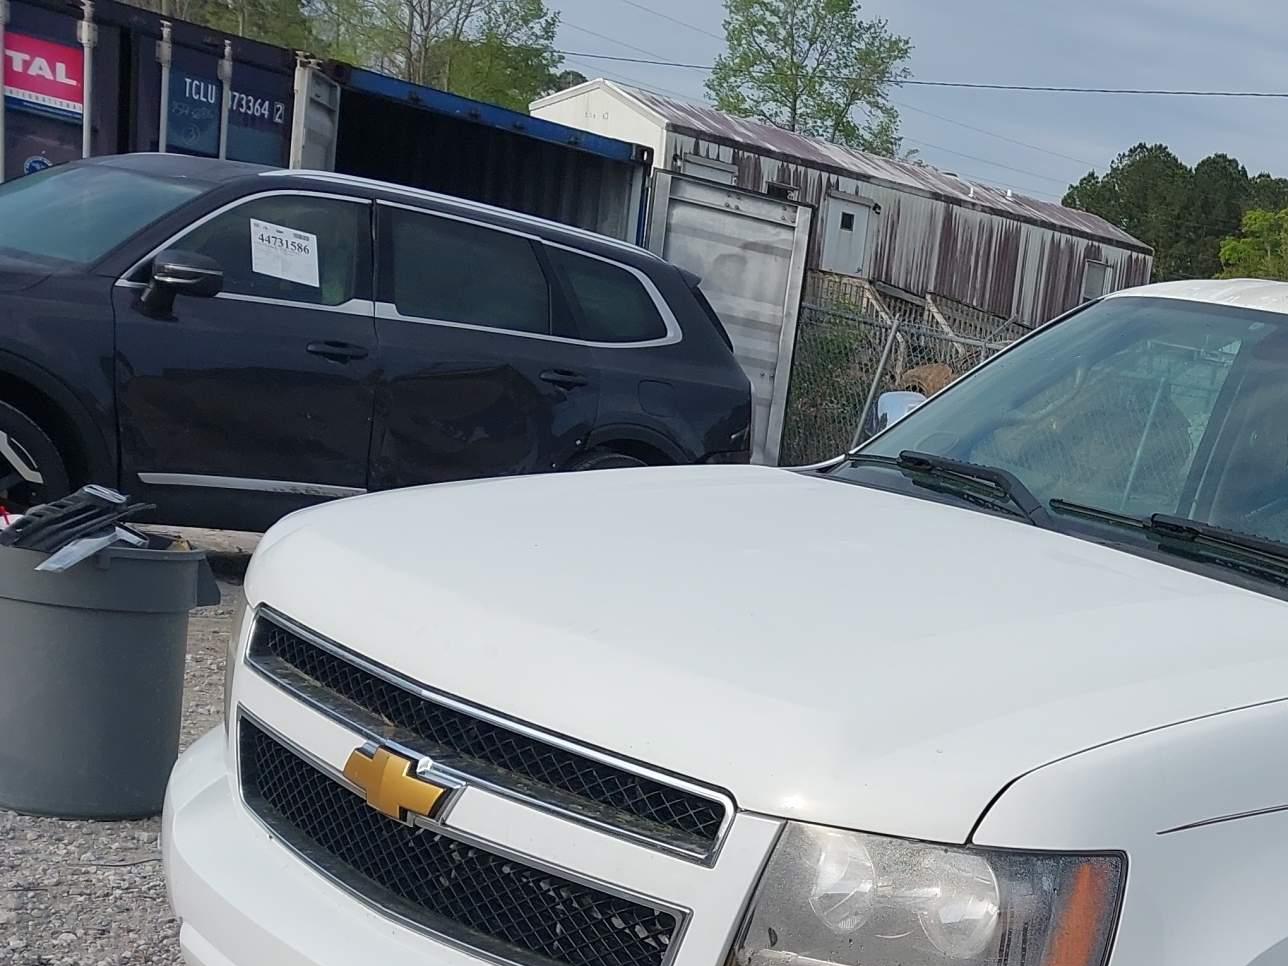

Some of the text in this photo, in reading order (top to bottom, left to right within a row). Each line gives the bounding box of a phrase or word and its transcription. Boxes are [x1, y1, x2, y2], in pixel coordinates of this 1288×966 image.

[5, 49, 77, 86] TAL
[185, 78, 216, 104] TCLU
[275, 104, 283, 121] 2
[258, 233, 310, 255] 44731586
